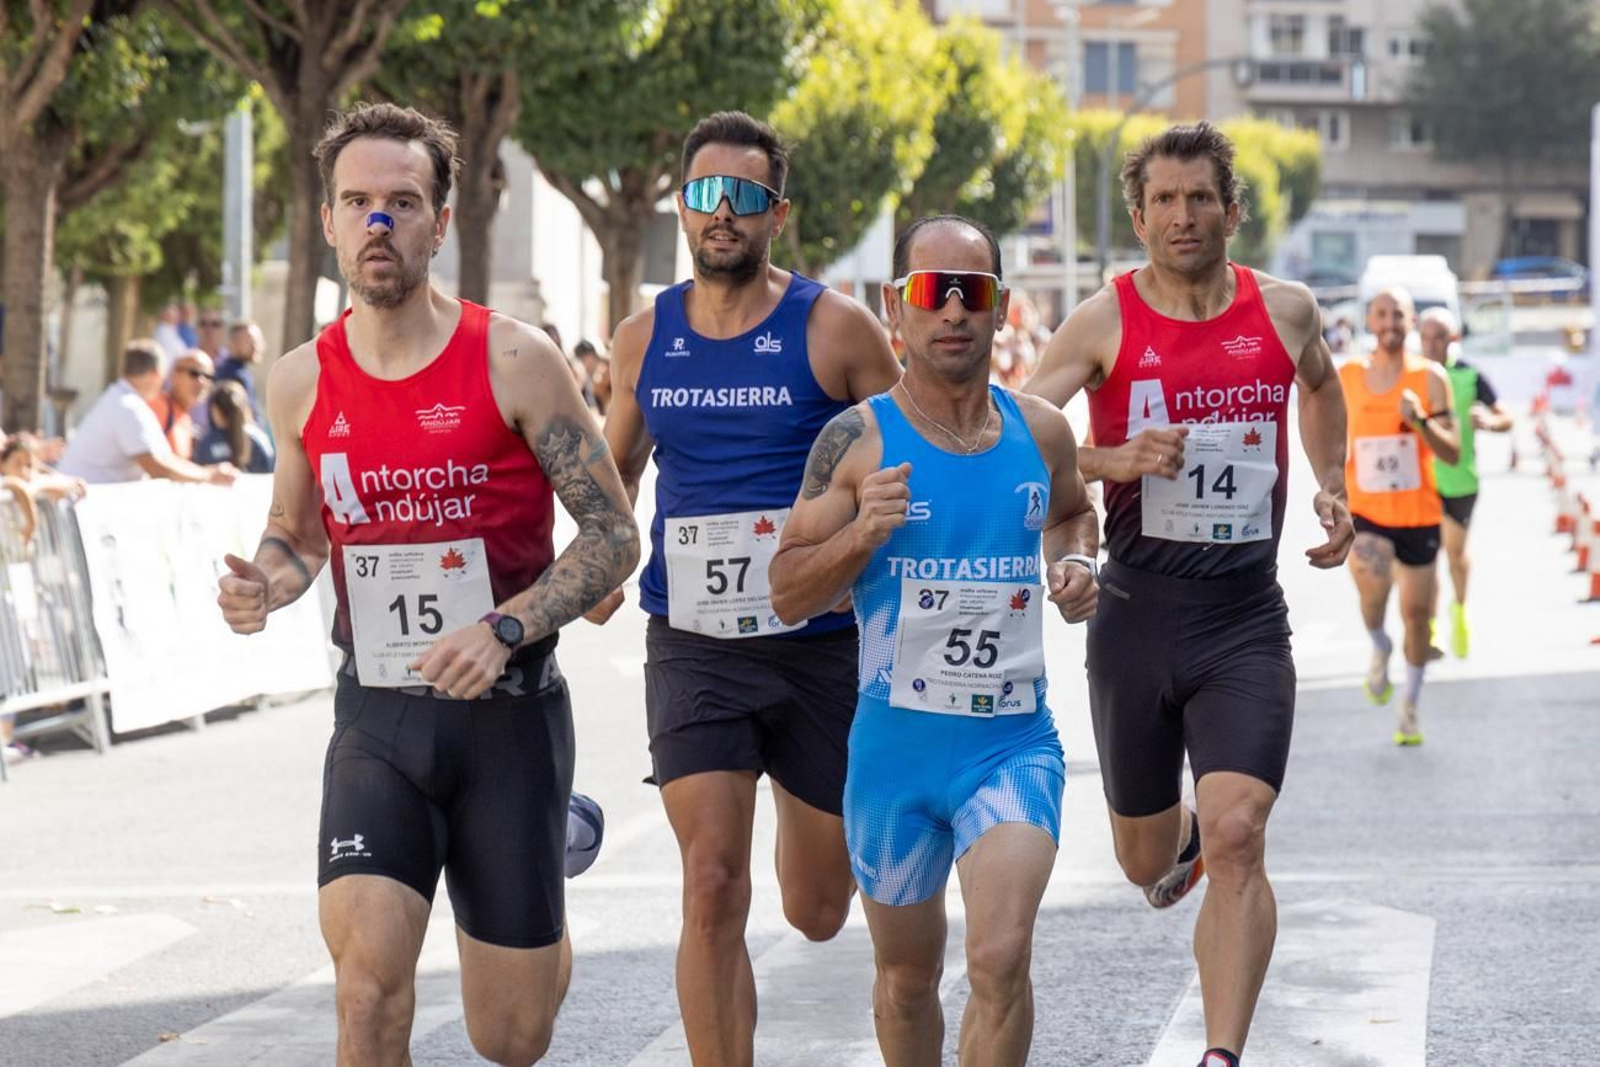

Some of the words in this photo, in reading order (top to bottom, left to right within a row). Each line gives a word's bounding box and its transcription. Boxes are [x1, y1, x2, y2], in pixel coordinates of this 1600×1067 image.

[651, 386, 793, 407] TROTASIERRA
[1188, 463, 1237, 500] 14
[678, 525, 699, 545] 37
[356, 555, 380, 578] 37
[706, 556, 752, 596] 57
[887, 555, 1040, 580] TROTASIERRA
[389, 593, 444, 636] 15
[943, 628, 1001, 669] 55
[940, 670, 962, 678] PEDRO
